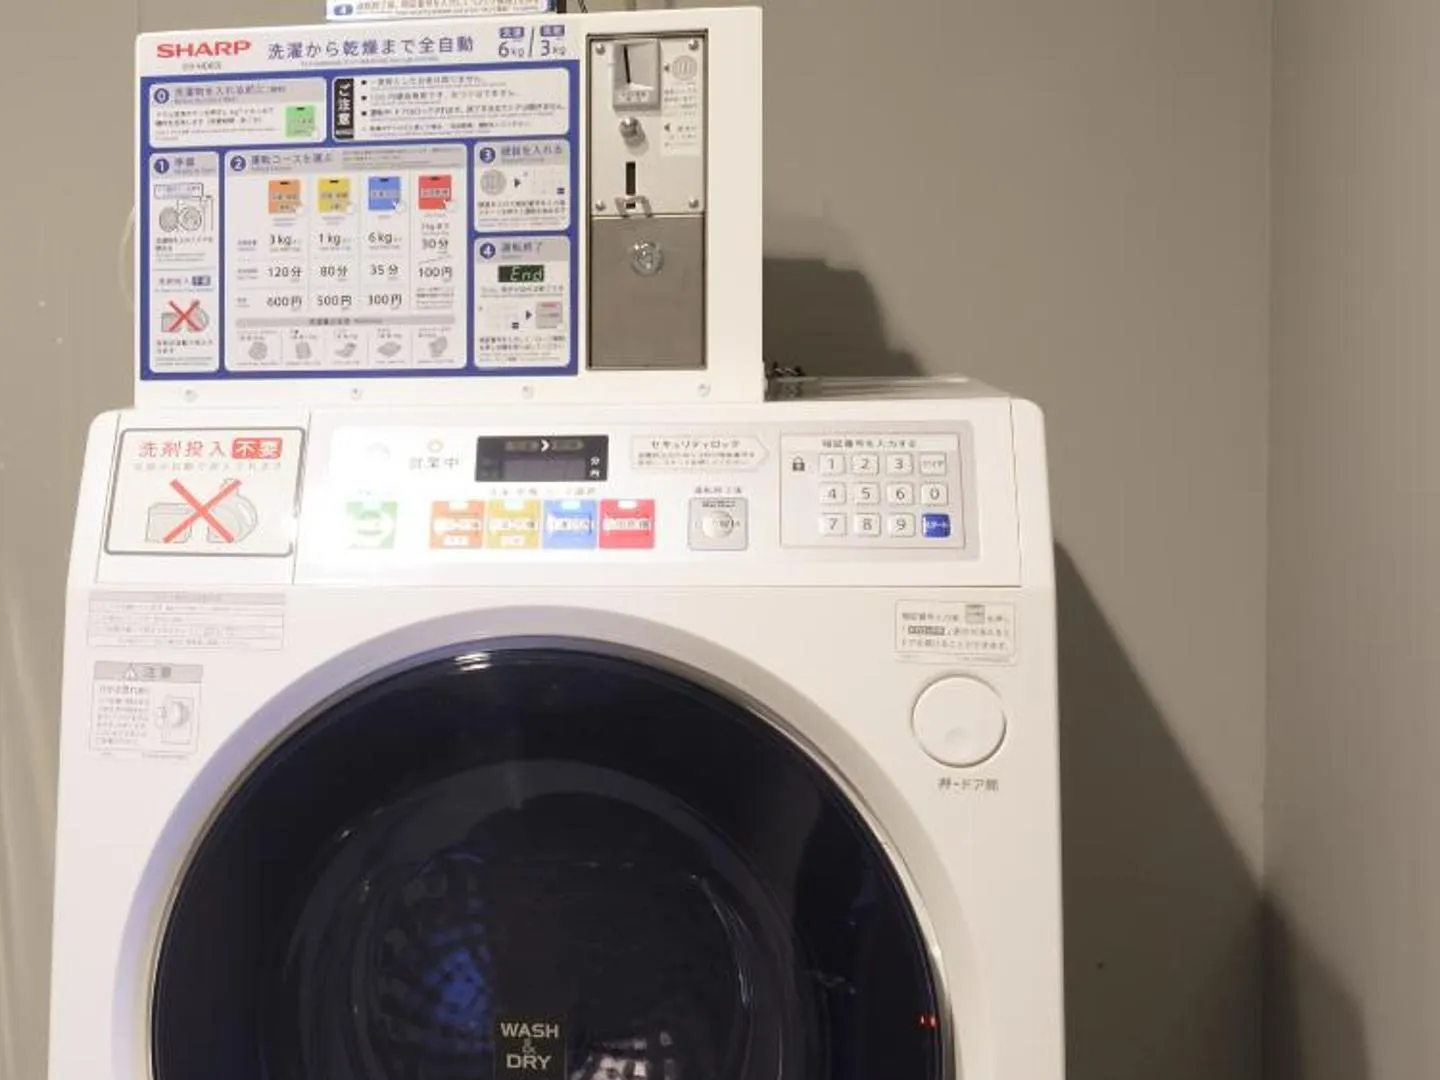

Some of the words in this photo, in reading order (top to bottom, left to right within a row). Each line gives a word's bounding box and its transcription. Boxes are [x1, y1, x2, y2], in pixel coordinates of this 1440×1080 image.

[156, 40, 252, 58] SHARP
[268, 36, 473, 60] 洗濯から乾燥まで全自動
[418, 265, 453, 279] 100円
[829, 458, 834, 469] 1
[861, 458, 869, 469] 2
[895, 458, 903, 469] 3
[829, 489, 836, 499] 4
[862, 487, 870, 500] 5
[896, 489, 905, 500] 6
[930, 488, 939, 500] 0
[830, 518, 838, 530] 7
[863, 518, 872, 530] 8
[896, 519, 906, 530] 9
[500, 1022, 559, 1038] WASH
[506, 1053, 552, 1070] DRY
